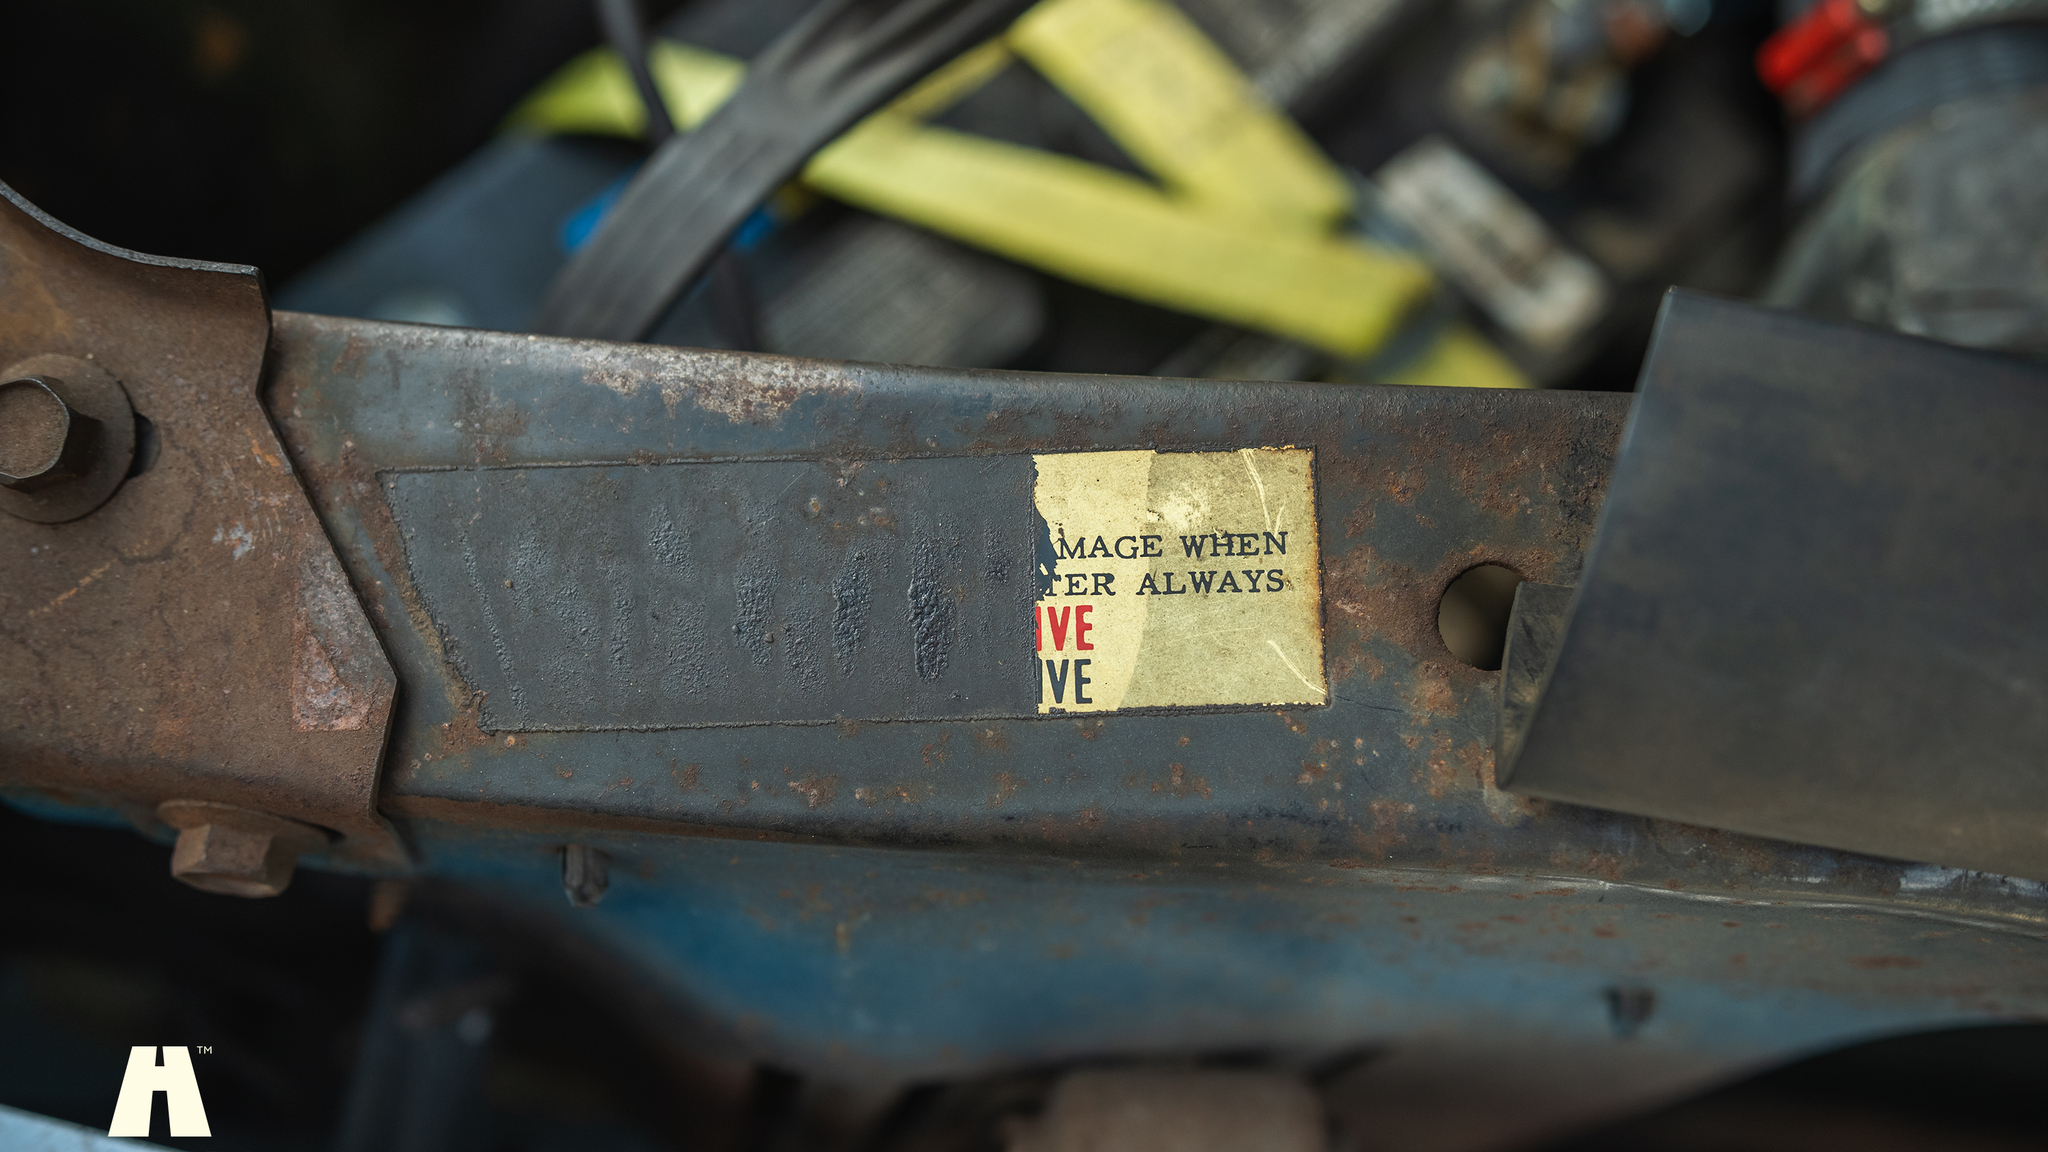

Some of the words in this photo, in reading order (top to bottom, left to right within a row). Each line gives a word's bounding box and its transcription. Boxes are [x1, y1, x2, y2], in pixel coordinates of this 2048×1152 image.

[1057, 534, 1163, 560] MAGE
[1179, 531, 1288, 558] WHEN
[1136, 569, 1285, 596] ALWAYS
